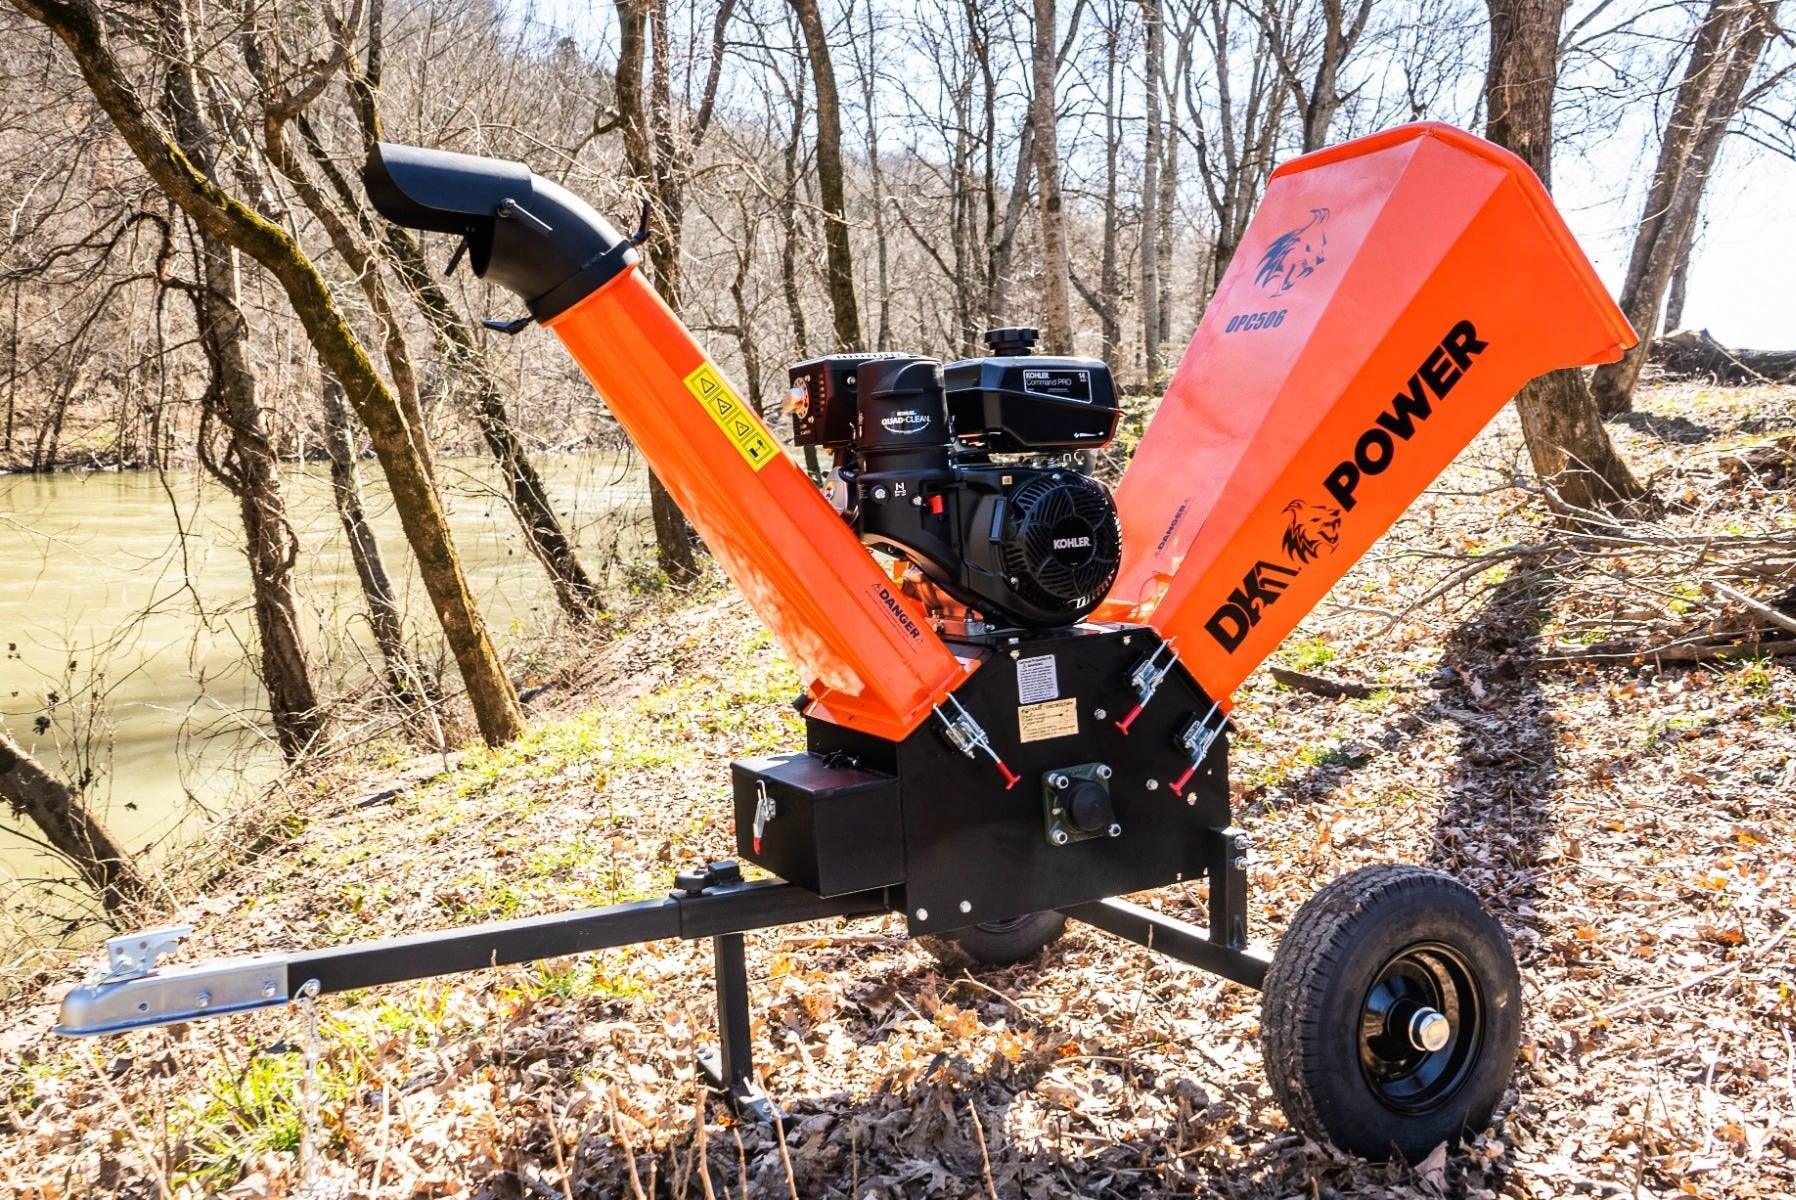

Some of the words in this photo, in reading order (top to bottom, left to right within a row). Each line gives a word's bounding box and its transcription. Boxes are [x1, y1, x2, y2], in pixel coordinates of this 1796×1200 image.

[1225, 309, 1288, 333] OPC506
[1057, 378, 1072, 386] PRO
[1322, 319, 1489, 513] POWER
[1053, 537, 1090, 550] KOHLER
[1157, 505, 1186, 550] DANGER
[879, 588, 920, 639] DANGER
